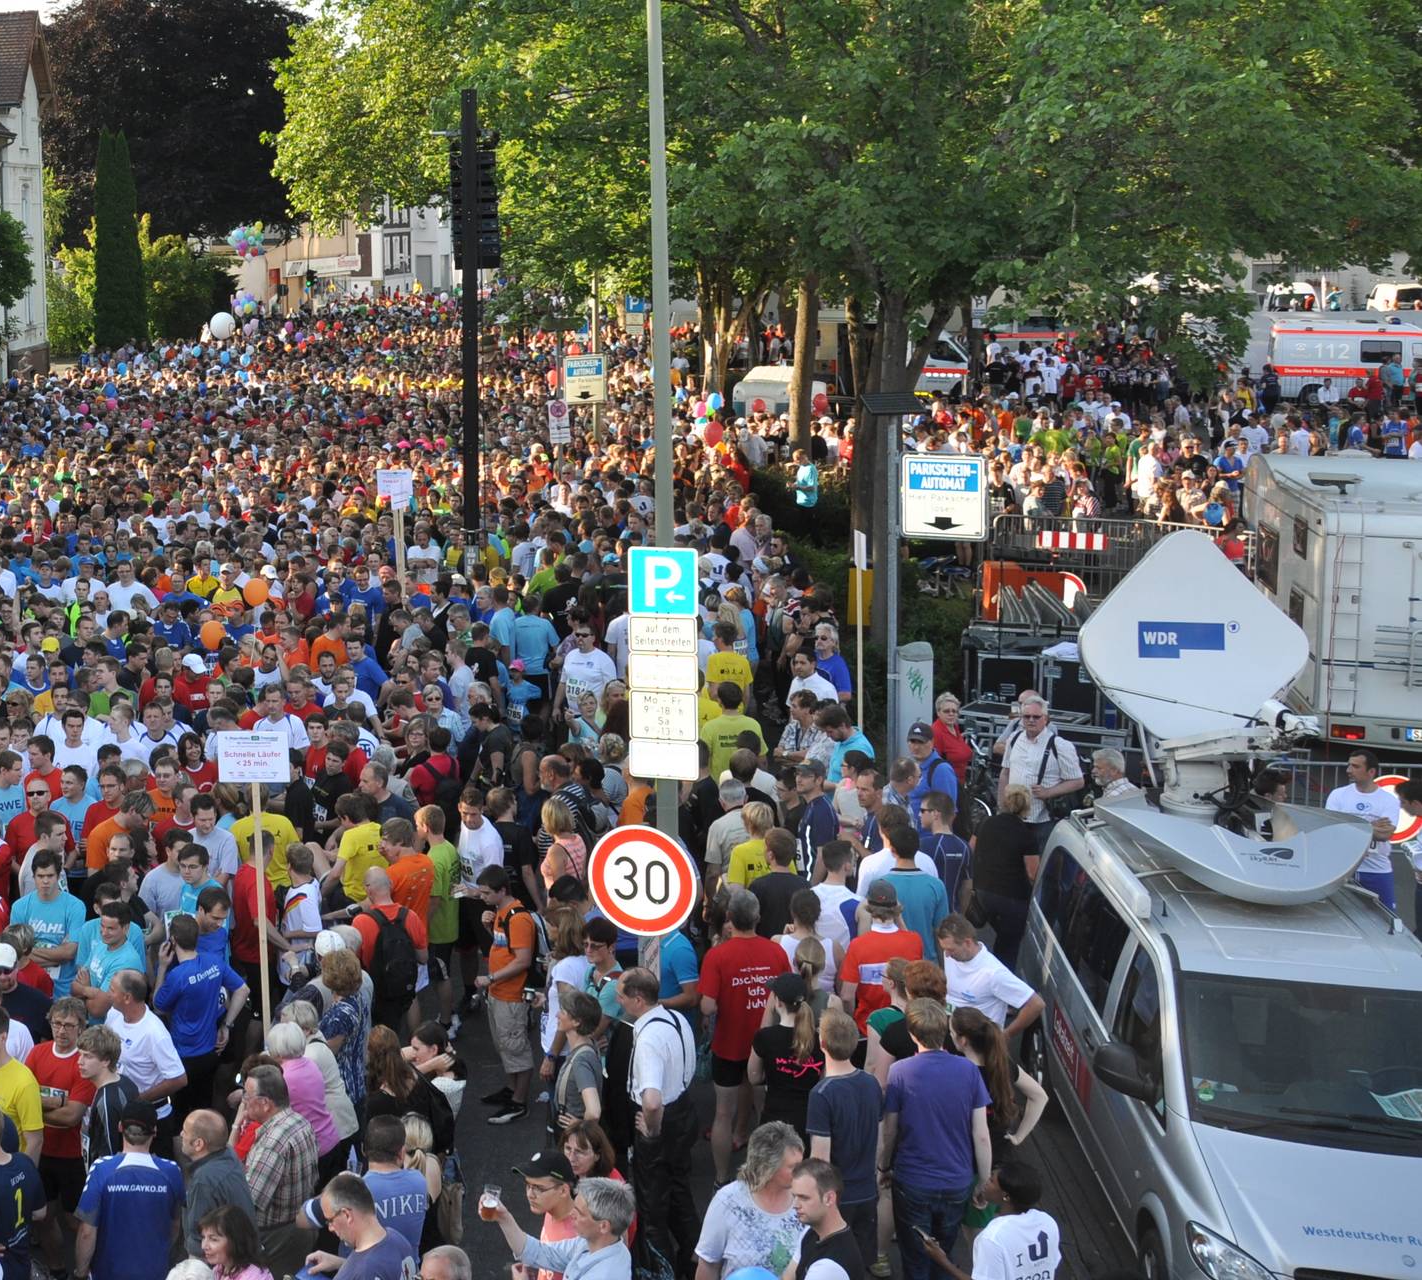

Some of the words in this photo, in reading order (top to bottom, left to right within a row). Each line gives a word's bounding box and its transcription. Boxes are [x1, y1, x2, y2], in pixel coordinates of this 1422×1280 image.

[1314, 343, 1351, 359] 112
[909, 462, 977, 478] PARKSCHEIN-
[920, 476, 967, 491] AUTOMAT
[644, 555, 682, 608] P
[662, 624, 680, 634] dem
[634, 635, 692, 647] Seitenstreifen
[1142, 631, 1179, 646] WDR
[644, 695, 658, 704] Mo
[257, 750, 281, 758] Läufer
[613, 855, 670, 906] 30
[107, 1184, 168, 1193] WWW.GAYKO.DE
[374, 1193, 426, 1220] NIKE
[1302, 1225, 1404, 1244] Westdeutscher
